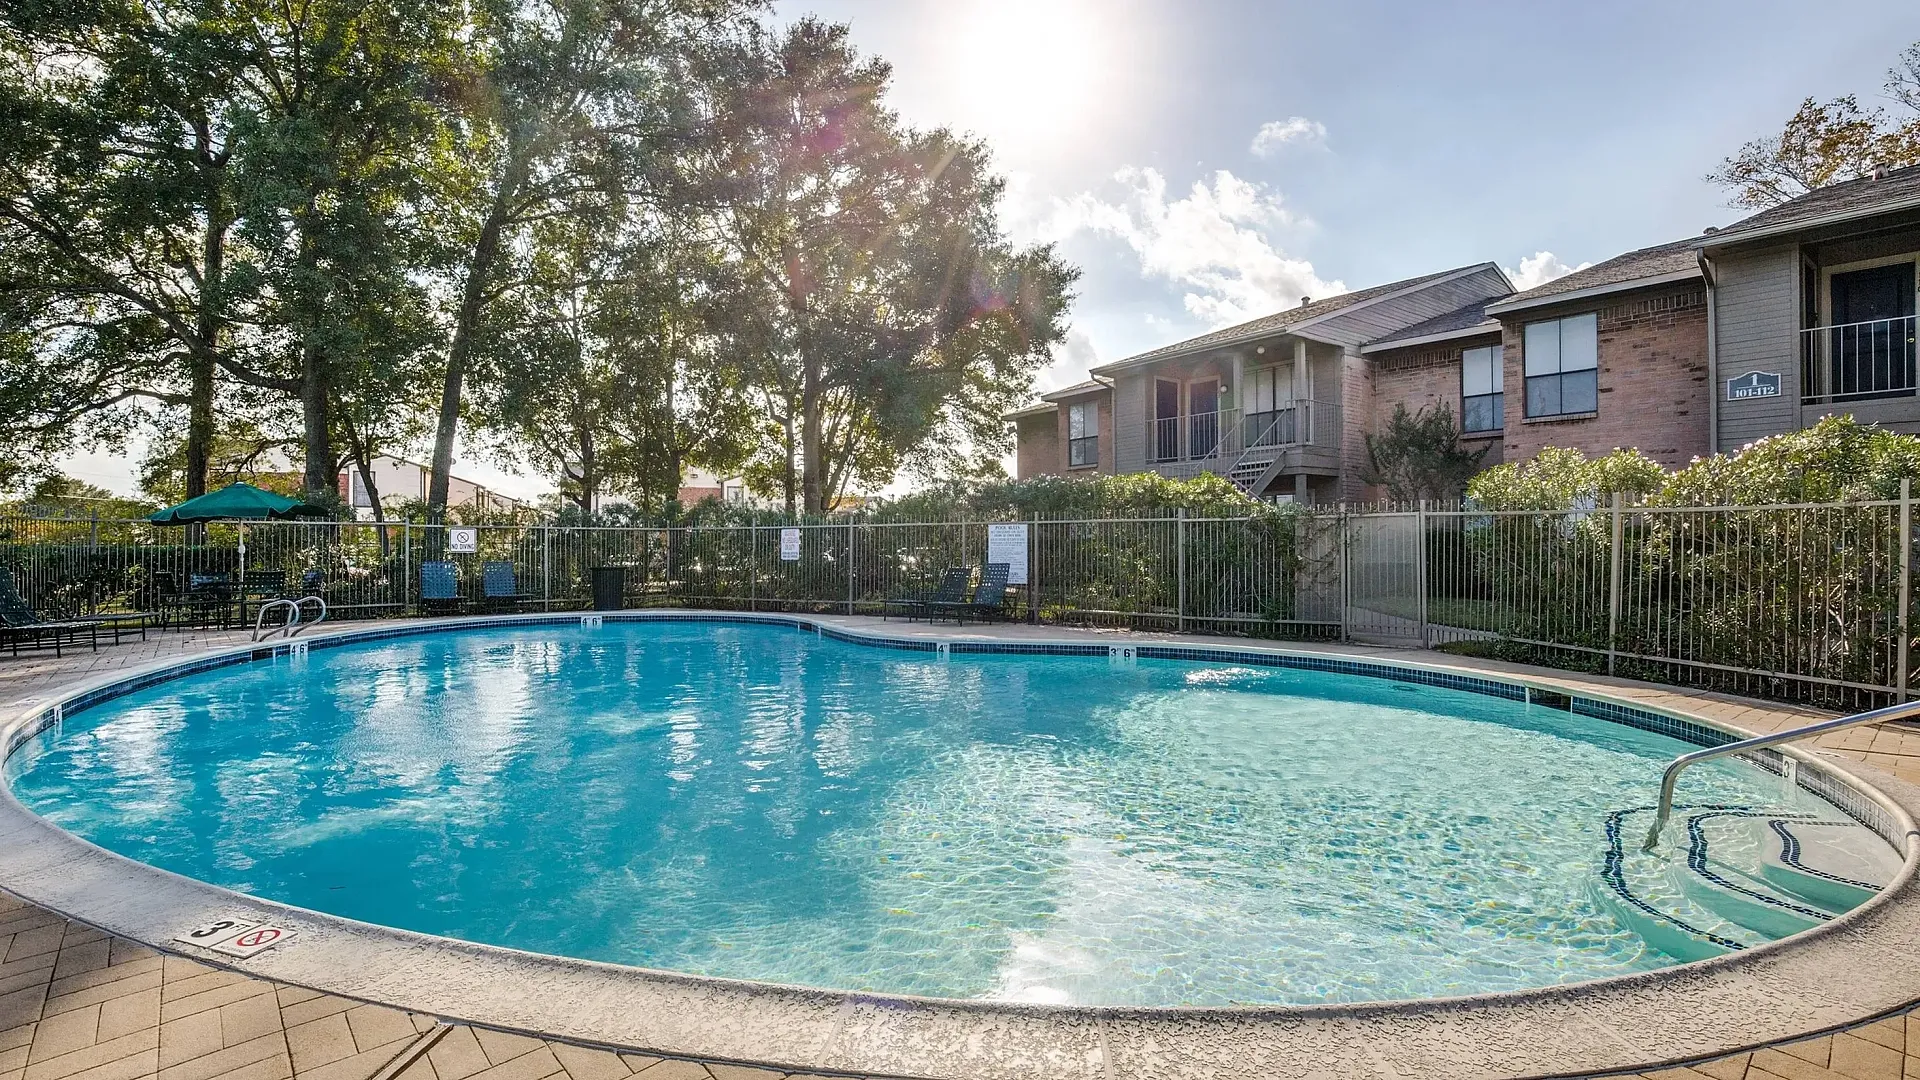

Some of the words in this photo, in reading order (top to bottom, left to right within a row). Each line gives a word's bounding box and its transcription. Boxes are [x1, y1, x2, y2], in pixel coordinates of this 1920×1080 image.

[1750, 373, 1758, 386] 1
[1735, 386, 1775, 398] 101-112
[290, 645, 296, 654] 4
[300, 643, 305, 654] 6
[1110, 647, 1117, 657] 3
[1124, 648, 1131, 658] 6
[1783, 760, 1790, 778] 3
[191, 921, 235, 938] 3
